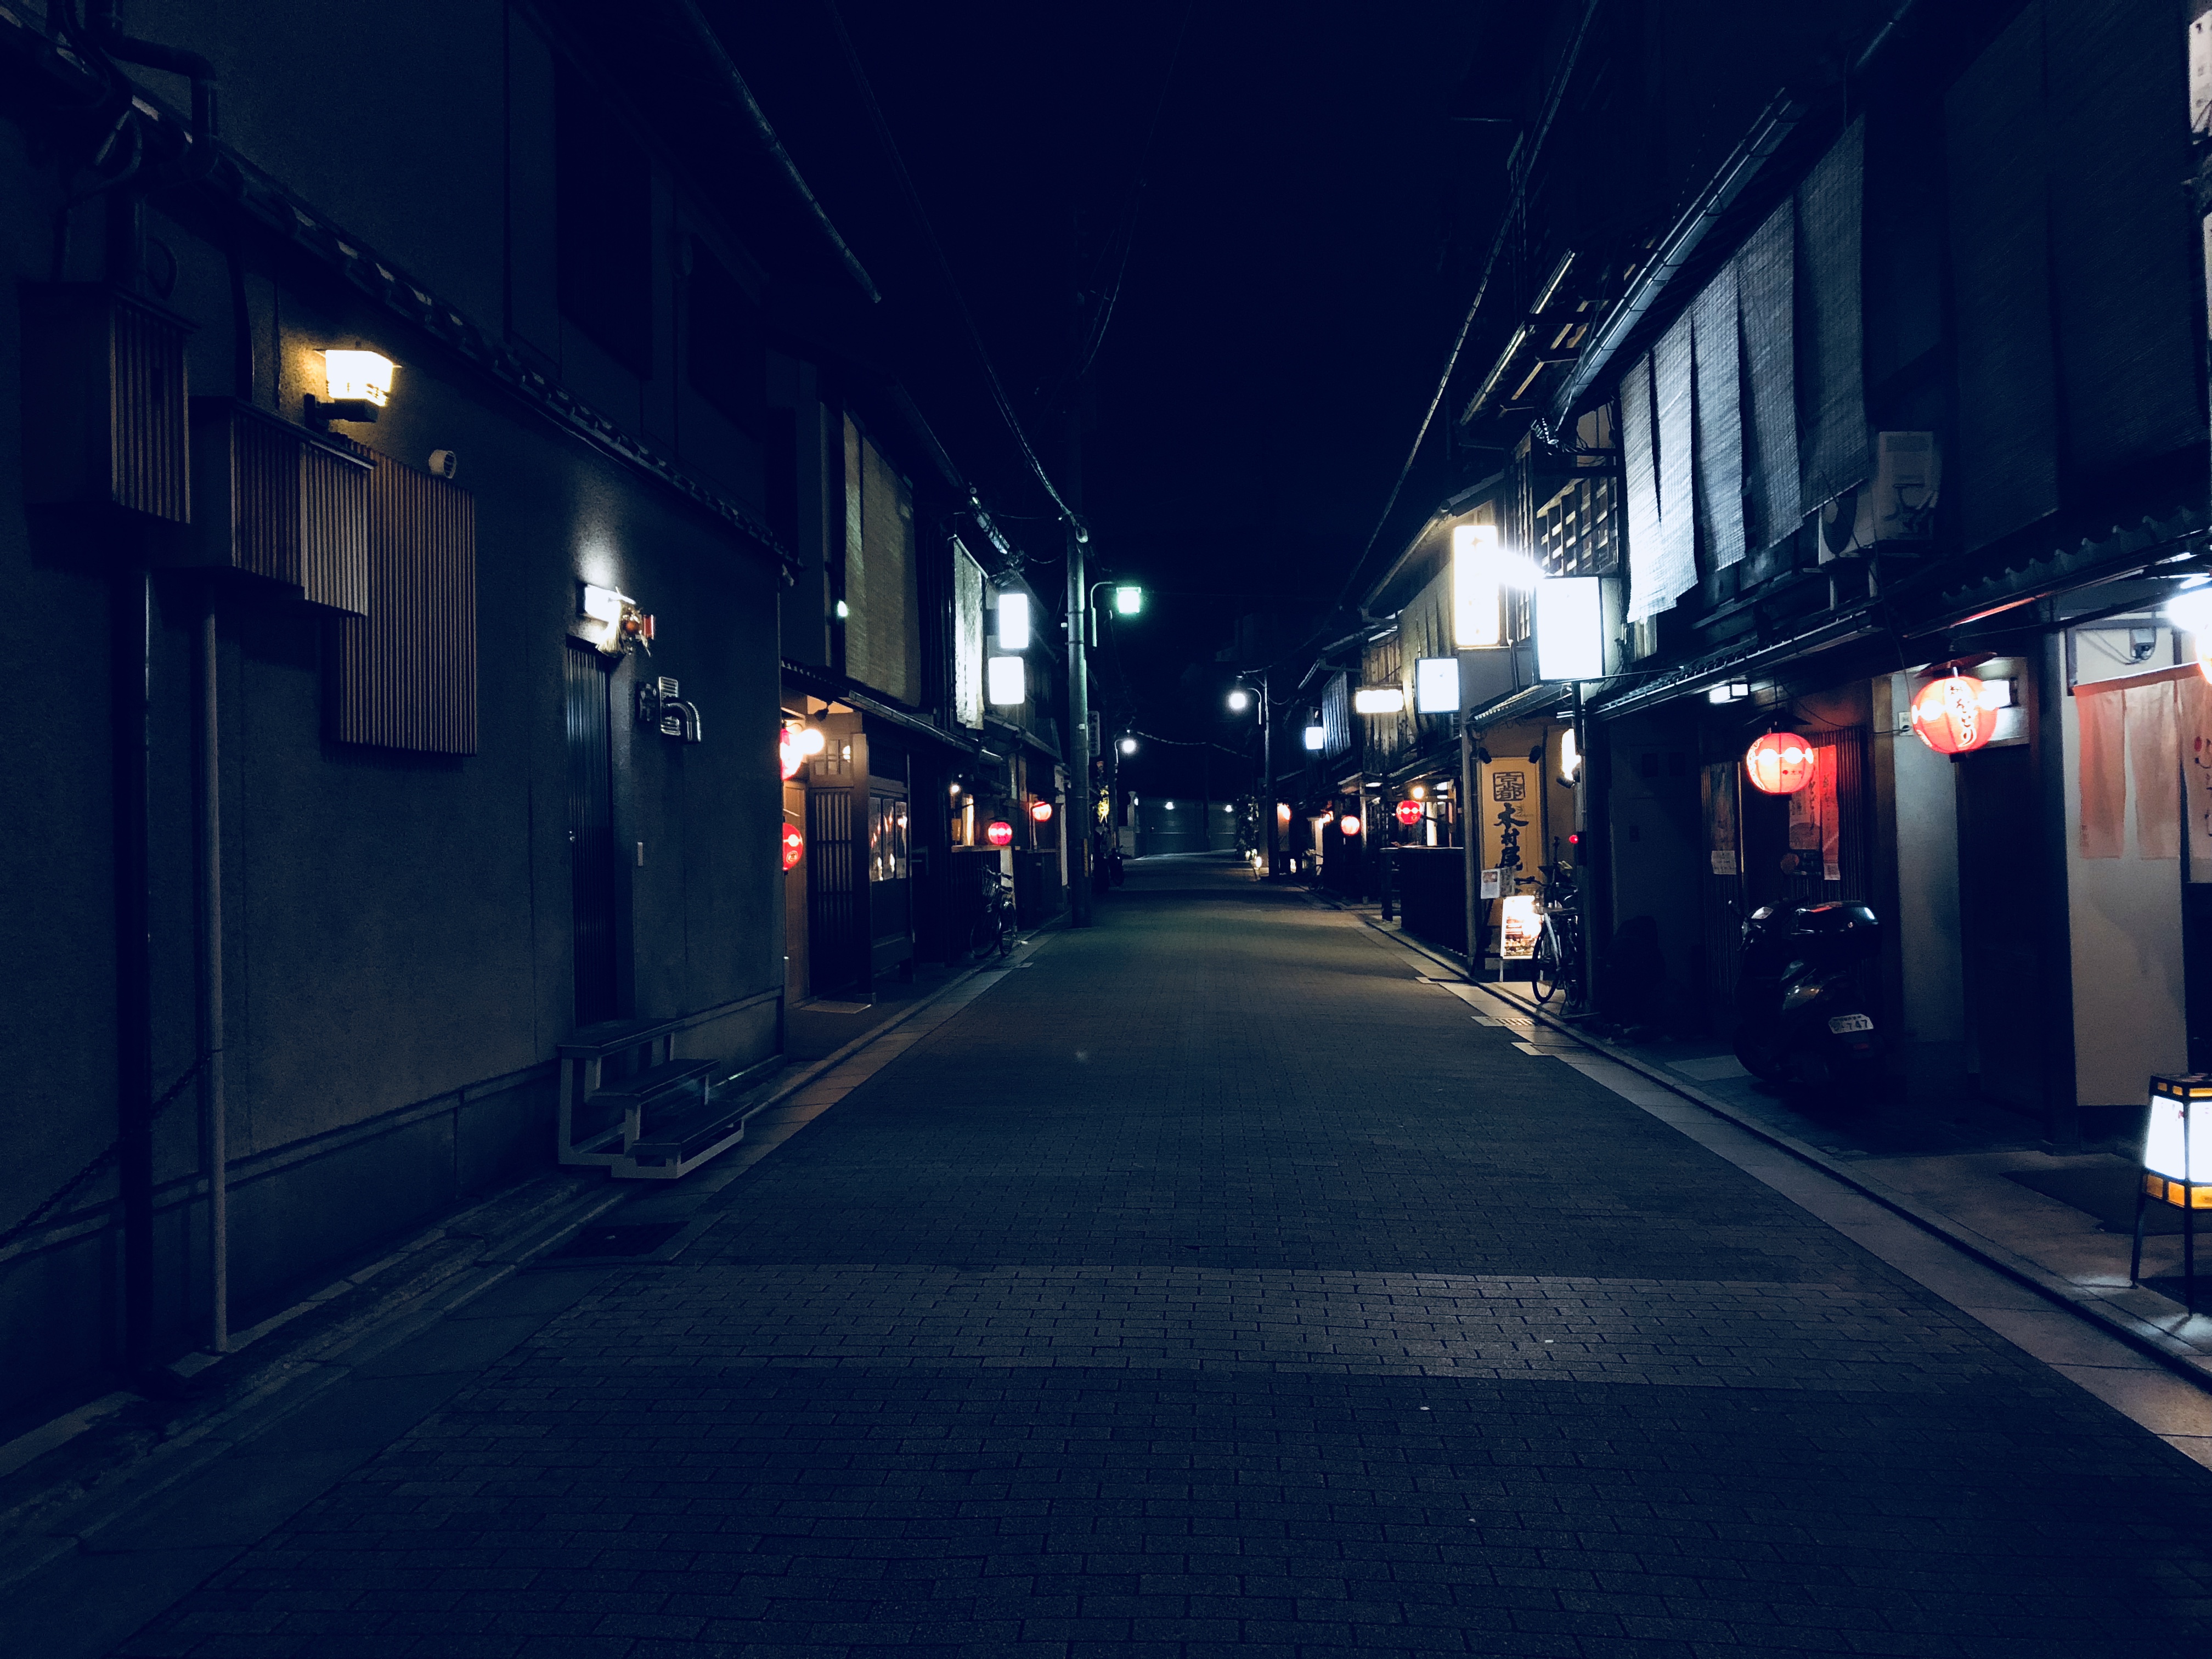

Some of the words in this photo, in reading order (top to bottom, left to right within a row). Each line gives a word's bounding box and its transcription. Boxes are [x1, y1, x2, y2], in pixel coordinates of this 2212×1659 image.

[1495, 773, 1523, 800] 京都
[1494, 803, 1529, 871] 木村屋
